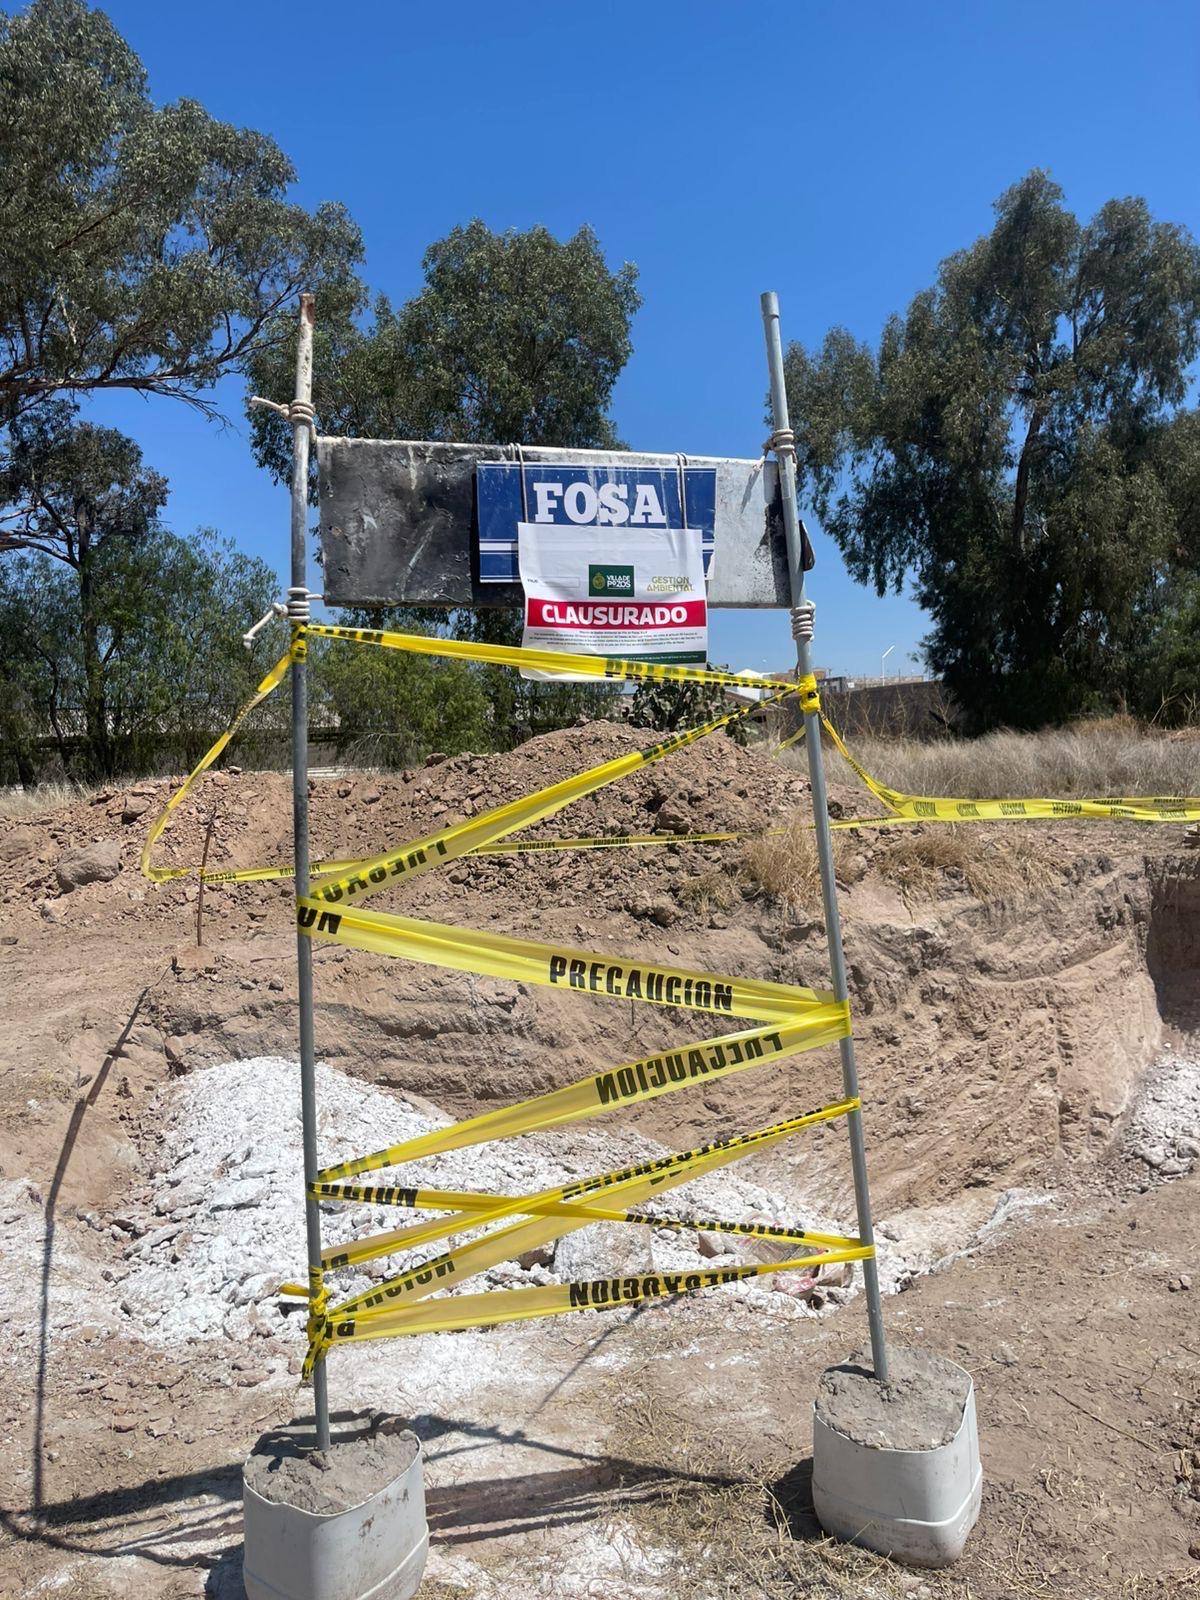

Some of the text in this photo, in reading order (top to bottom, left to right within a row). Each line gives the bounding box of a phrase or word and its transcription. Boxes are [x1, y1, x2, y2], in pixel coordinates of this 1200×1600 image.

[533, 482, 667, 524] FOSA
[542, 604, 688, 625] CLAUSURADO
[549, 955, 733, 1010] PRECAUCION
